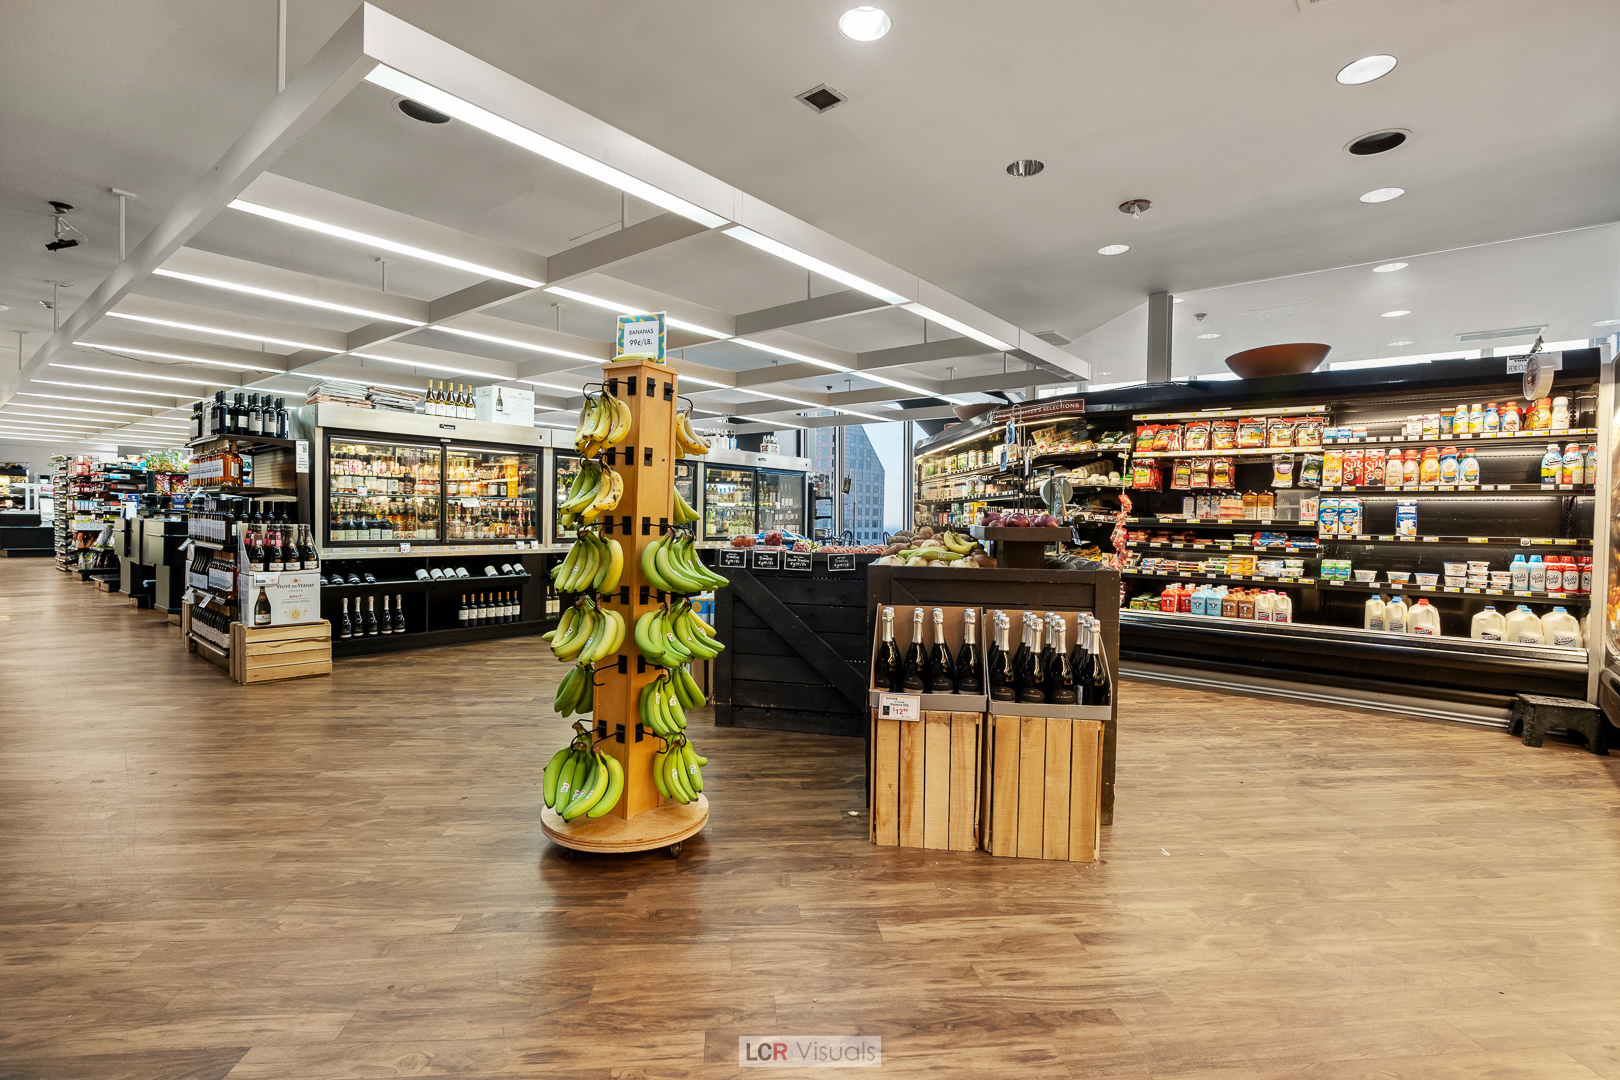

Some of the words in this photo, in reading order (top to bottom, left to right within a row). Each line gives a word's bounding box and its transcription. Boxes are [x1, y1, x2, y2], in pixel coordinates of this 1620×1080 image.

[1042, 402, 1080, 412] SELECTIONS
[1325, 460, 1340, 468] Silk
[1344, 460, 1363, 473] Silk
[1365, 460, 1384, 473] Silk
